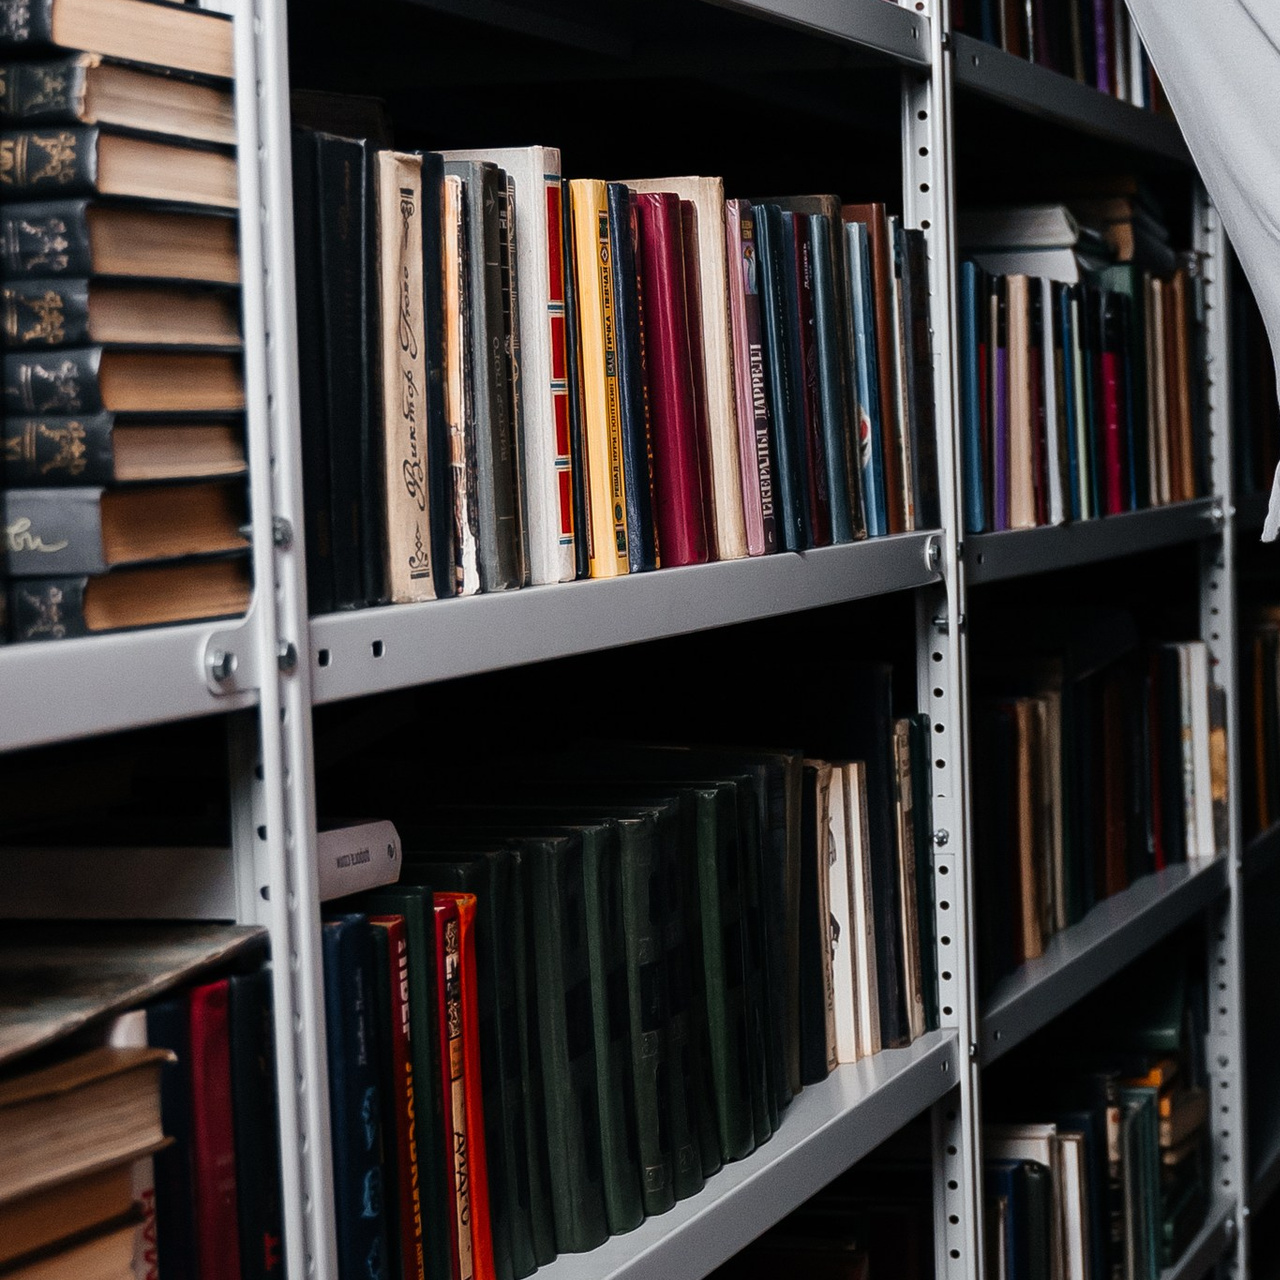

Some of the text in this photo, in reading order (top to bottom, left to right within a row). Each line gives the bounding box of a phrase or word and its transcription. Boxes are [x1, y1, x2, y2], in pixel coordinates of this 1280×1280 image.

[602, 266, 610, 309] ПЕВЧАЯ
[398, 265, 426, 511] Виктор Гюго
[609, 383, 617, 433] ГЮНТЕКИН
[494, 396, 508, 462] ВИКТОР
[749, 343, 774, 520] ДЖЕРАЛЬД ДАРРЕЛЛ
[612, 466, 620, 498] РЕШАД
